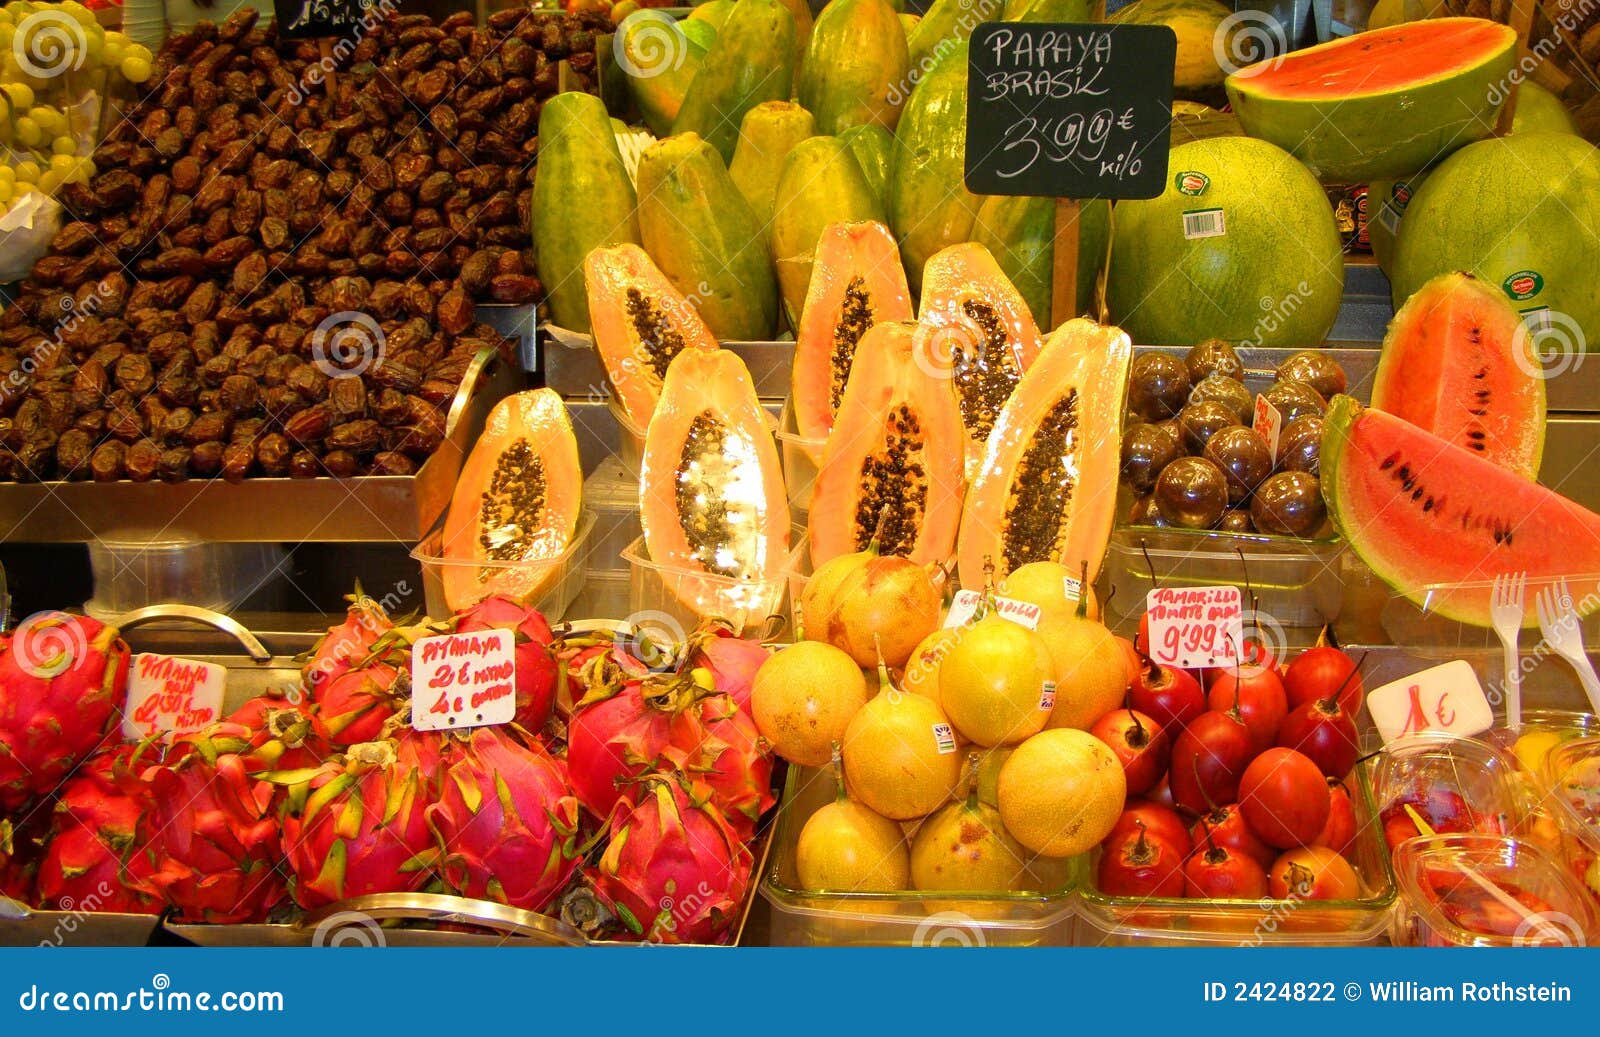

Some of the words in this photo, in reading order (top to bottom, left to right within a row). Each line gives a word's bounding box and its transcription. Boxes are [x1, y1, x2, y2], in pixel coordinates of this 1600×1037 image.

[983, 28, 1113, 67] PAPAYA
[1157, 623, 1217, 661] 9'99
[1435, 692, 1456, 728] €
